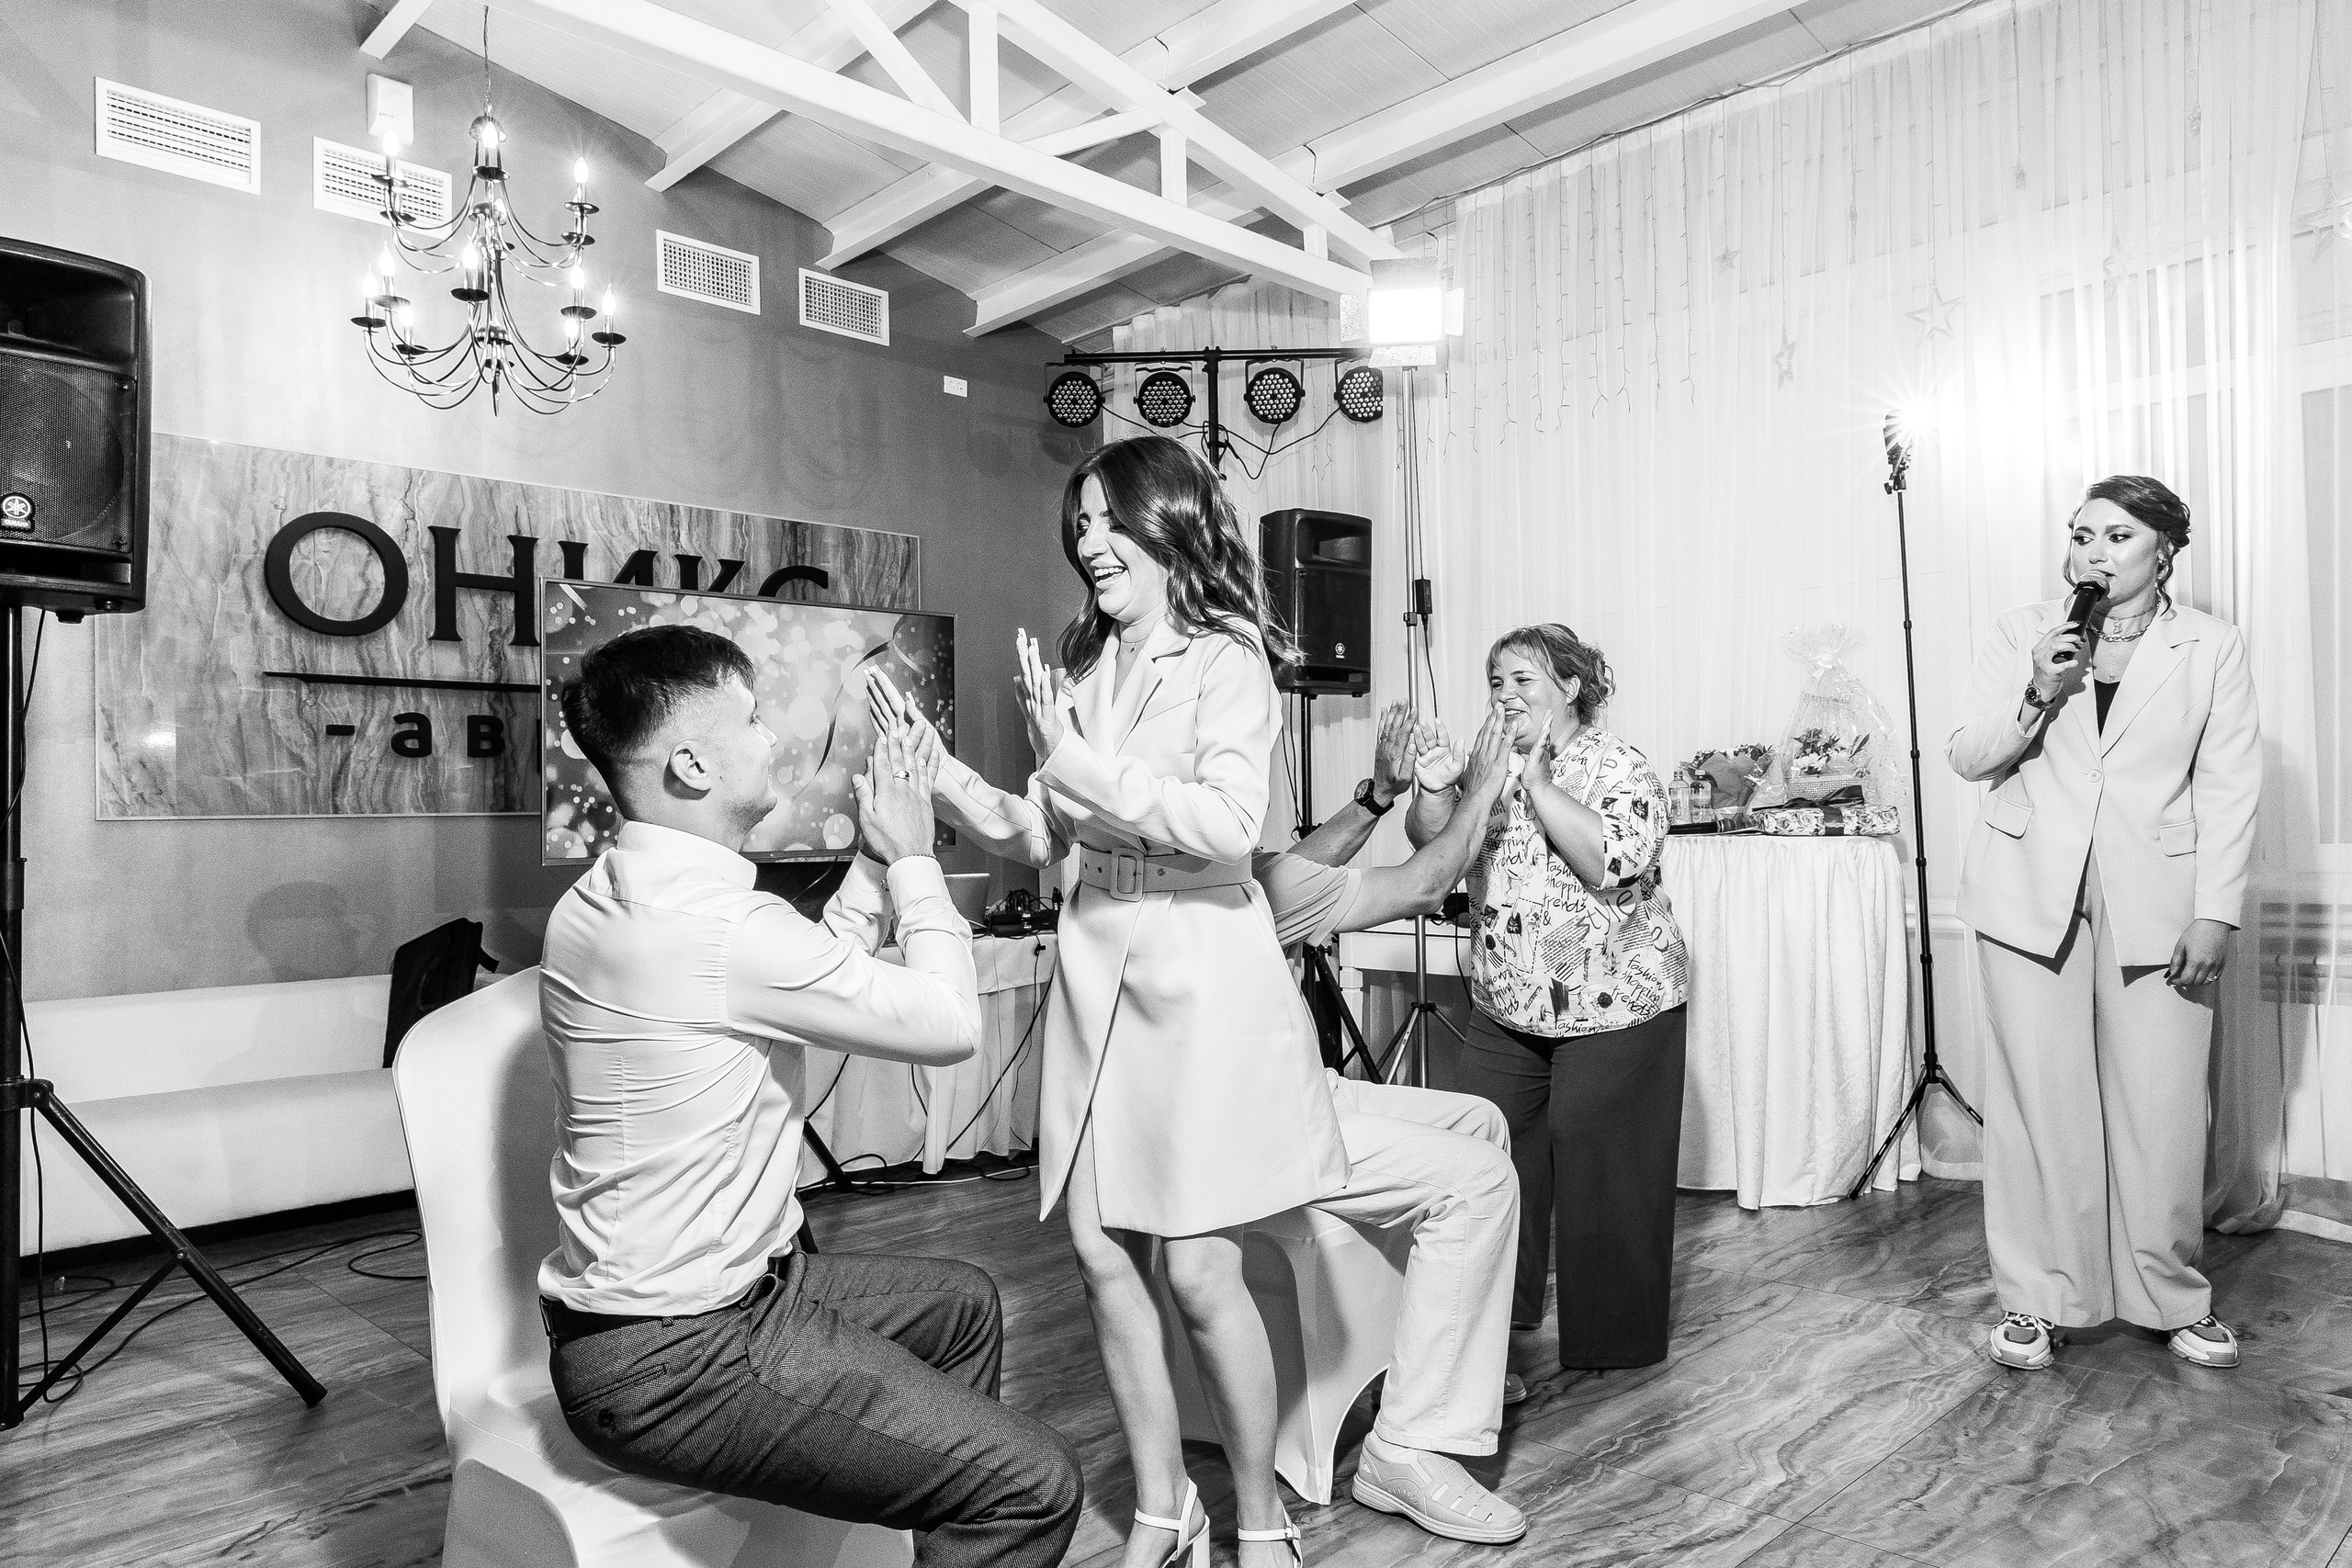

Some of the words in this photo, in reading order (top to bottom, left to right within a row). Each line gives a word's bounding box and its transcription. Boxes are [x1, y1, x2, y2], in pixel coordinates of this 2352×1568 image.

[1543, 892, 1587, 913] trends
[1627, 953, 1665, 991] fashion
[1554, 1012, 1598, 1033] fashion
